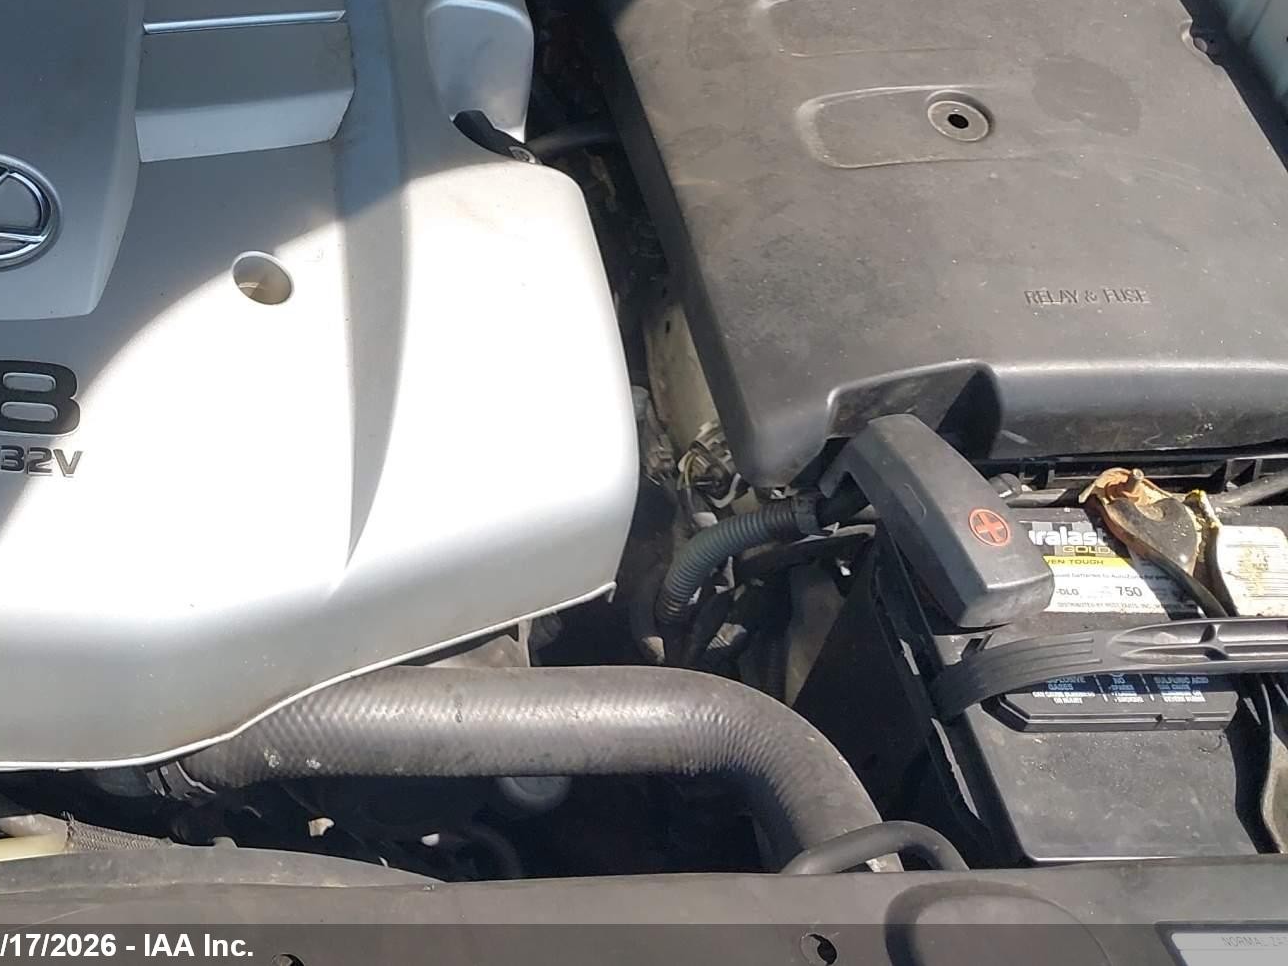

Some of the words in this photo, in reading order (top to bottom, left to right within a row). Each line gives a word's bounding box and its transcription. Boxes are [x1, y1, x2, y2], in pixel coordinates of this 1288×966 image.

[1024, 289, 1078, 304] RELAY
[1084, 290, 1097, 303] &
[1103, 288, 1150, 304] FUSE
[0, 444, 83, 478] 32V
[1028, 526, 1109, 546] ralast
[1063, 545, 1111, 554] GOLD
[1115, 586, 1143, 597] 750
